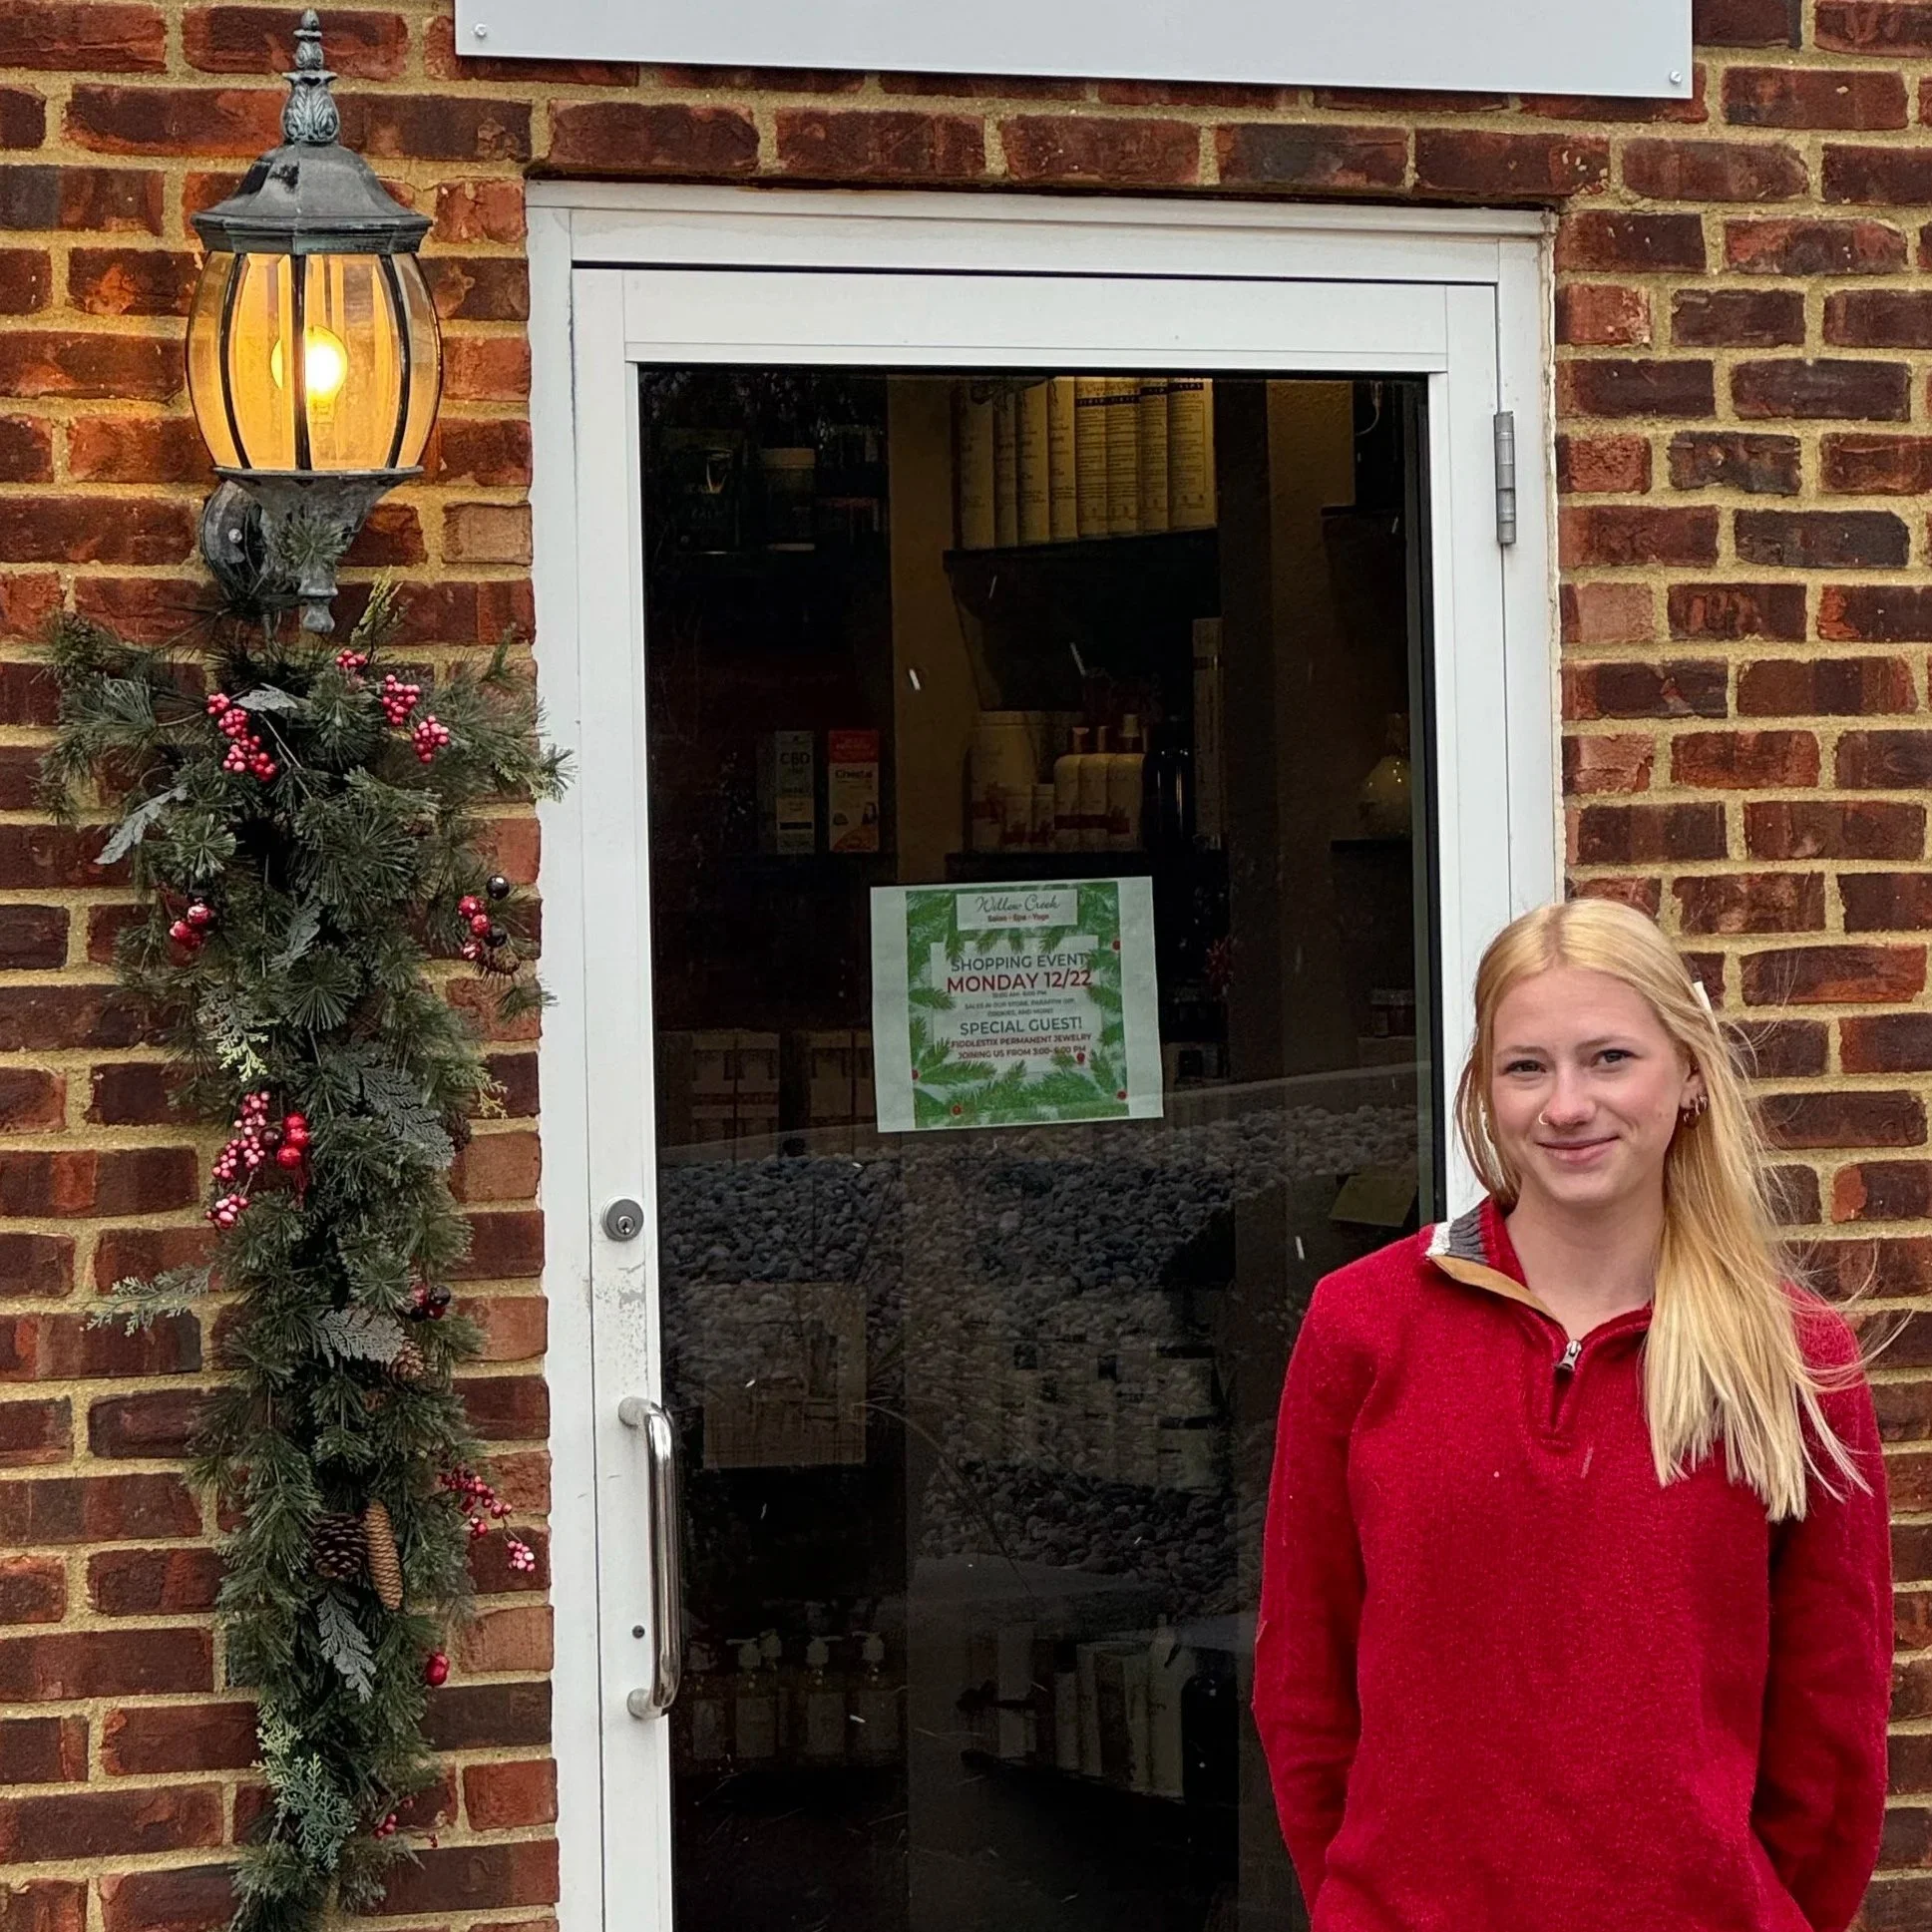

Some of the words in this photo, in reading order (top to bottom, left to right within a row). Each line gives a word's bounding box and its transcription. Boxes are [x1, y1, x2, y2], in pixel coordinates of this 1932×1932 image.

[975, 896, 1022, 913] Willow
[1024, 894, 1060, 911] Creek
[951, 956, 1031, 971] SHOPPING
[1037, 953, 1085, 967] EVENT
[947, 972, 1038, 992] MONDAY
[1044, 968, 1093, 989] 12/22
[960, 1019, 1025, 1035] SPECIAL
[1028, 1016, 1083, 1032] GUEST!
[951, 1038, 998, 1048] FIDDLESTIX
[999, 1035, 1051, 1045] PERMANENT
[1053, 1033, 1092, 1042] JEWELRY
